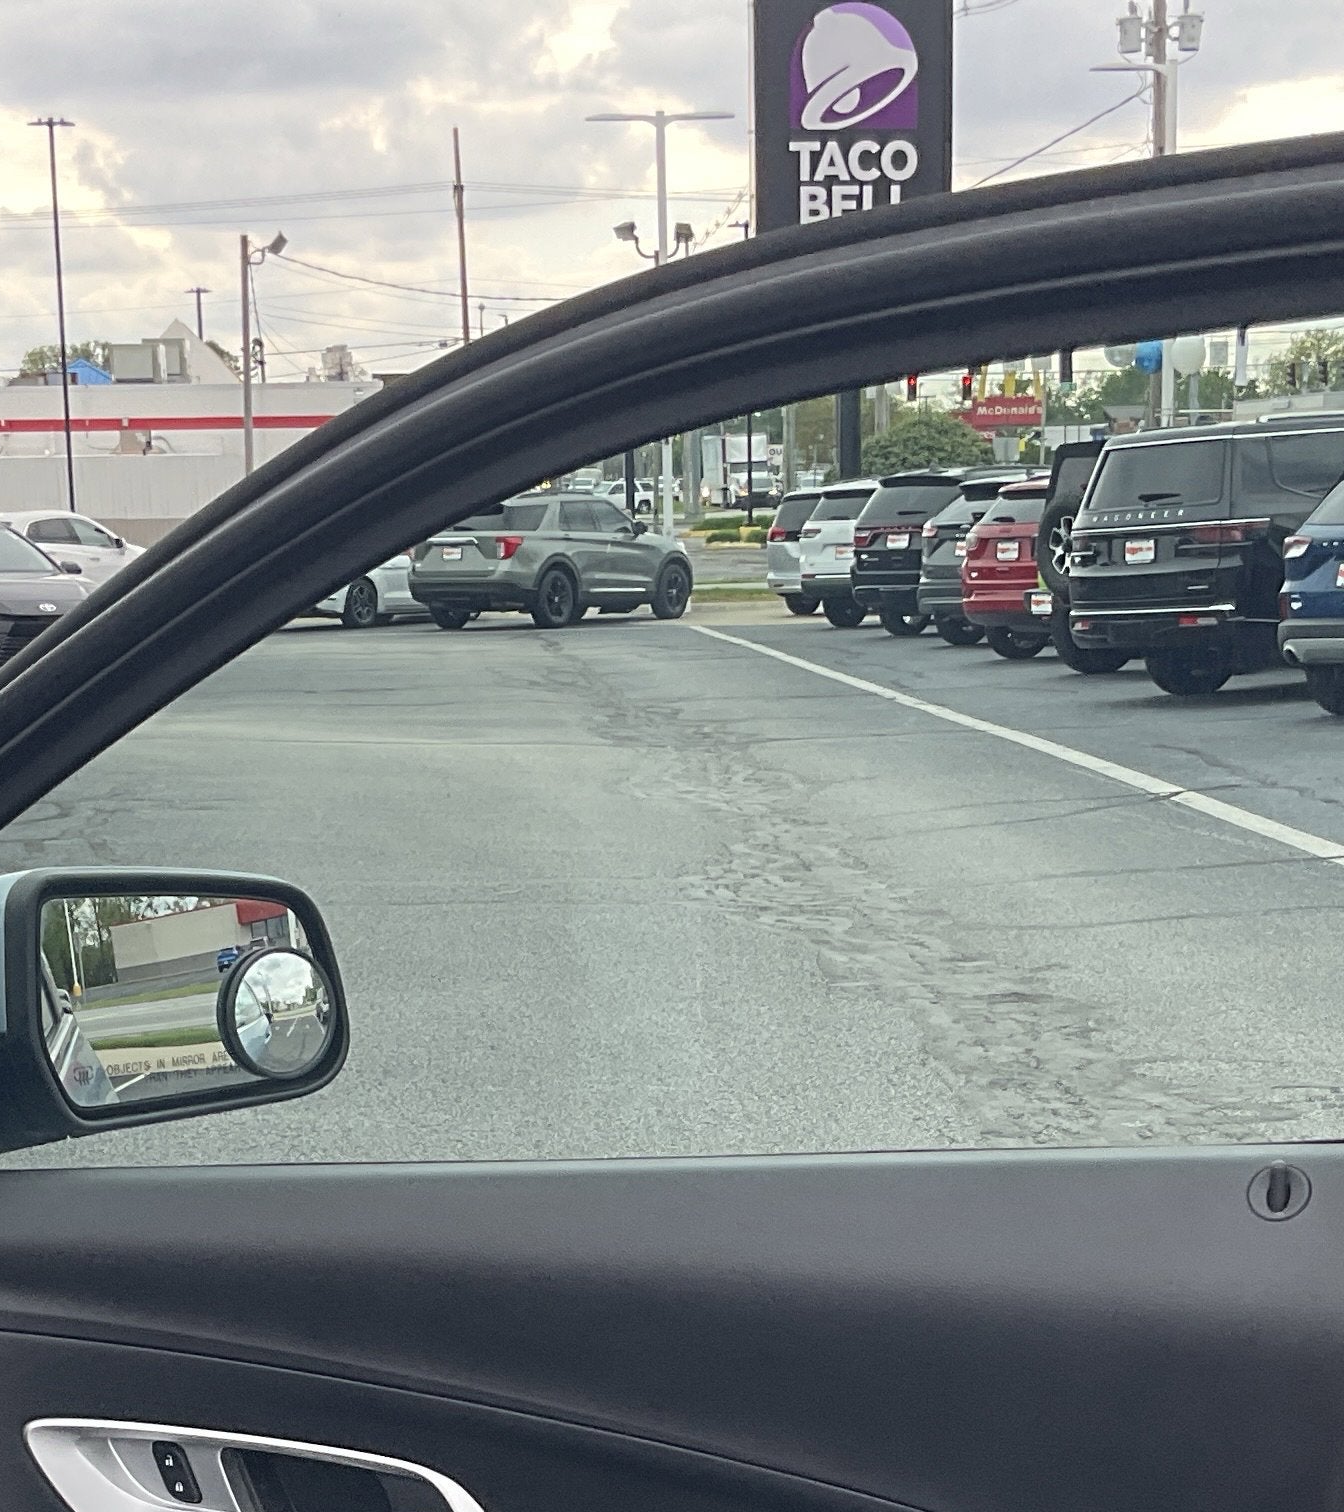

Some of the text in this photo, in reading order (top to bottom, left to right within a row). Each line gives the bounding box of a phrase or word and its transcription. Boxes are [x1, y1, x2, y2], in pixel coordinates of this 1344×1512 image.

[788, 139, 918, 182] TACO
[976, 404, 1043, 416] McDonald's
[1091, 509, 1185, 523] WAGONEER
[105, 1050, 230, 1076] OBJECTS IN MIRROR ARE
